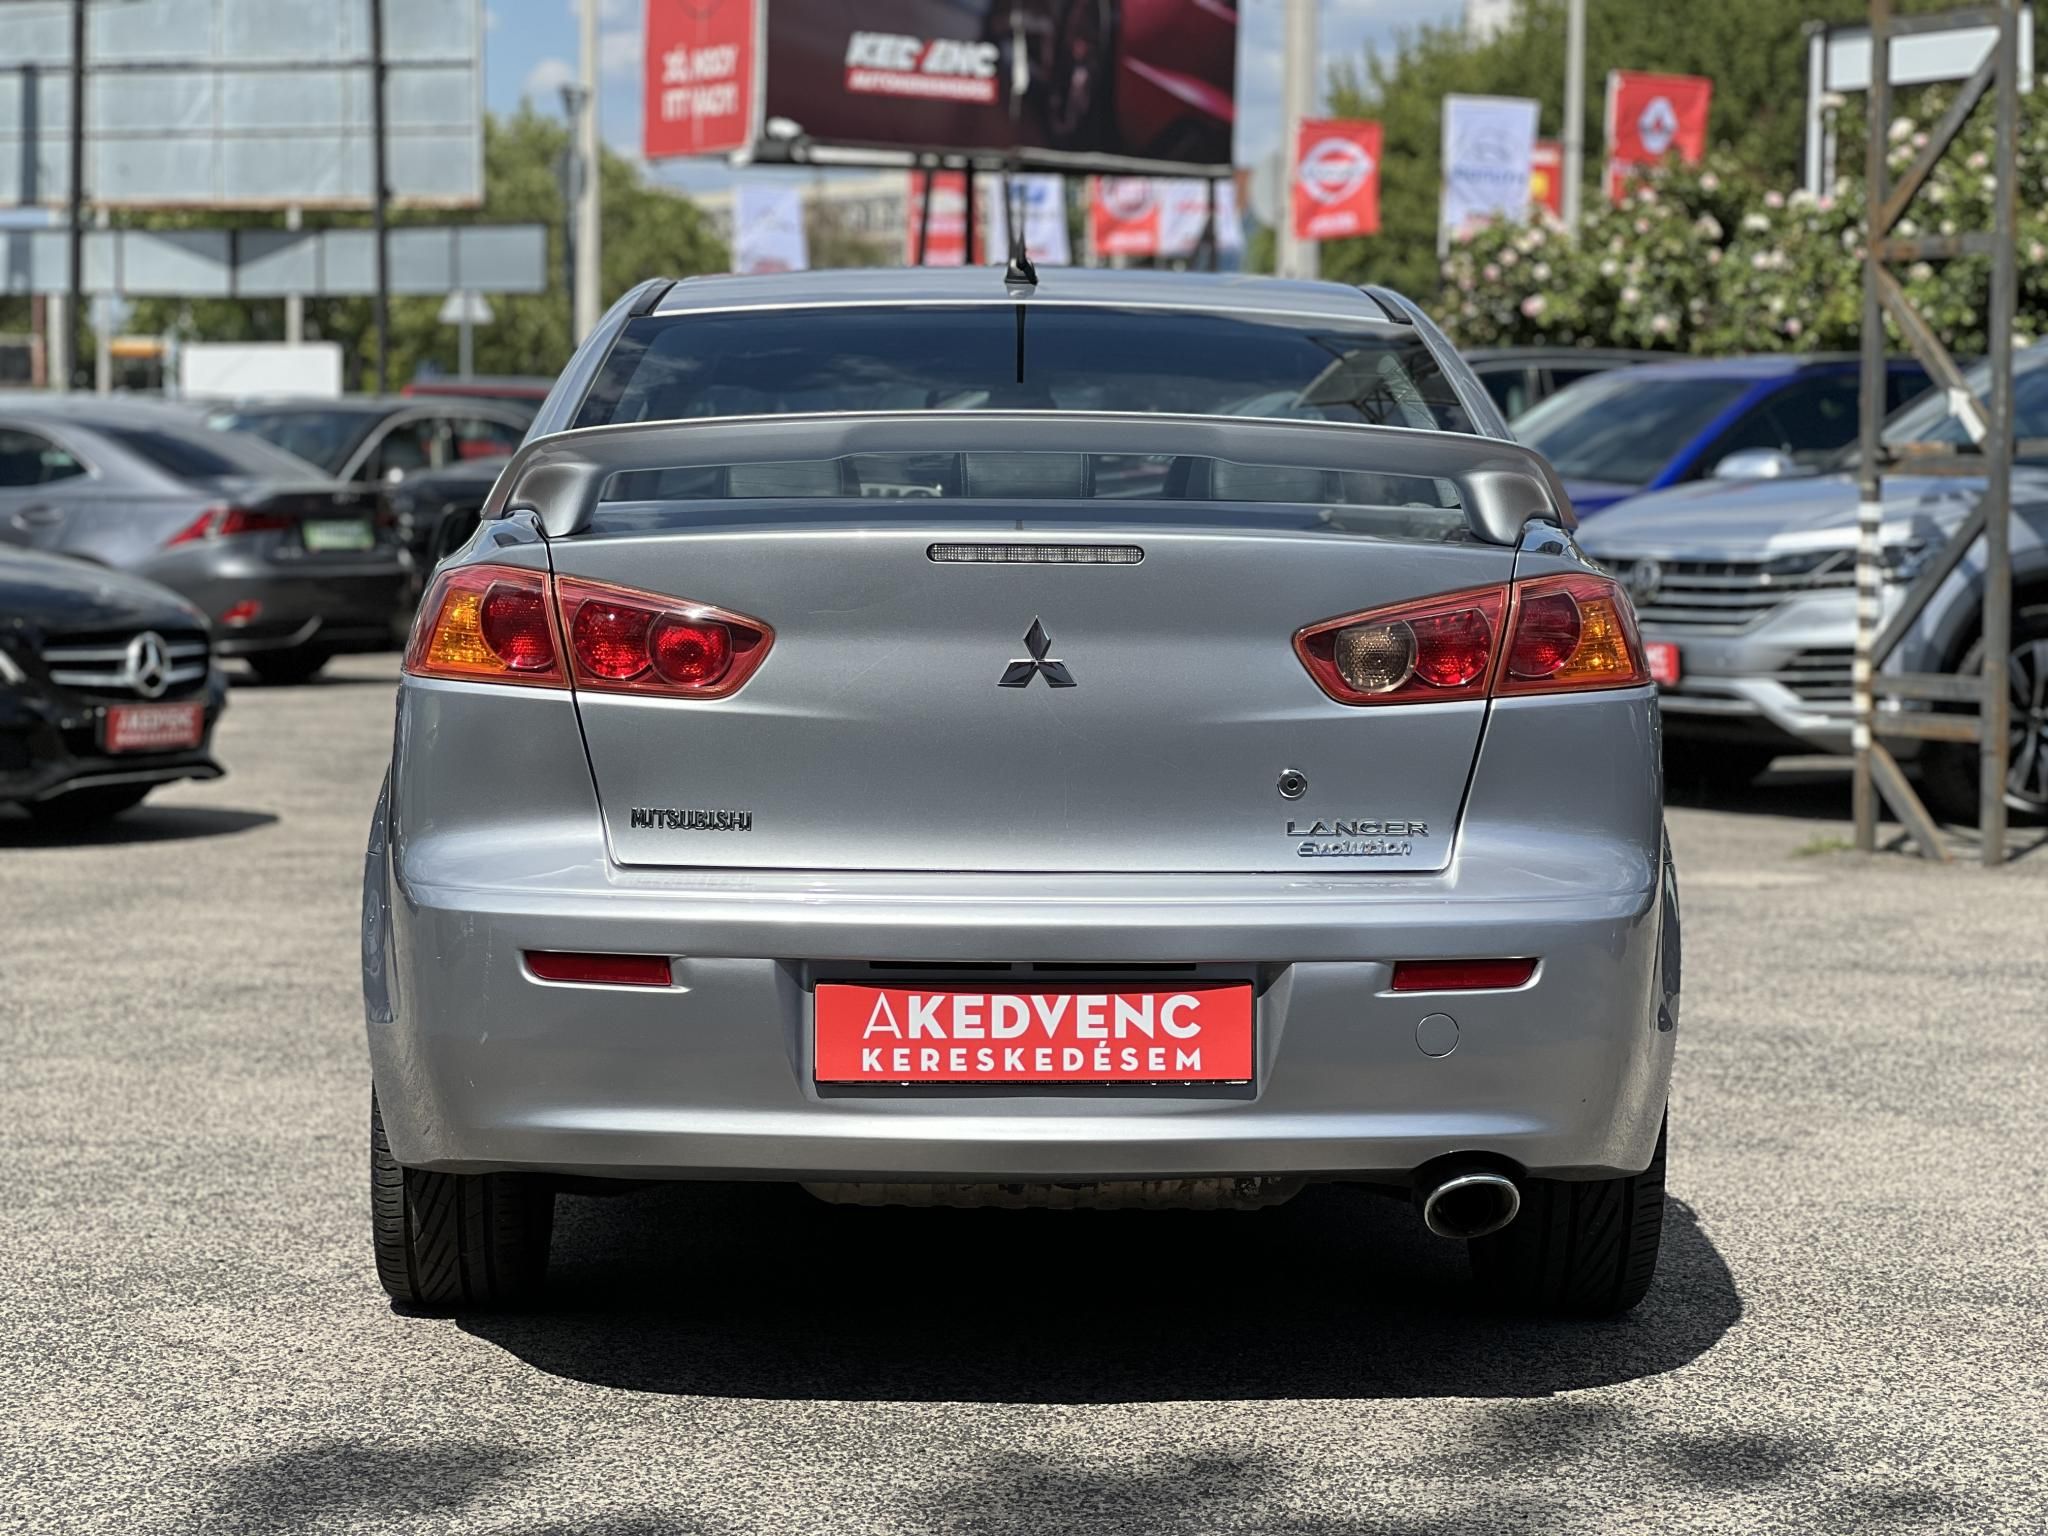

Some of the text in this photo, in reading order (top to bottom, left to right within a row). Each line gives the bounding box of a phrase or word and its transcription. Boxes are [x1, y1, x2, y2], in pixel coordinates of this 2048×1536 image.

[631, 807, 752, 831] MITSUBISHI
[1286, 819, 1430, 837] LANCER
[1297, 839, 1412, 857] Evolution
[862, 1041, 1202, 1072] KERESKEDÉSEM
